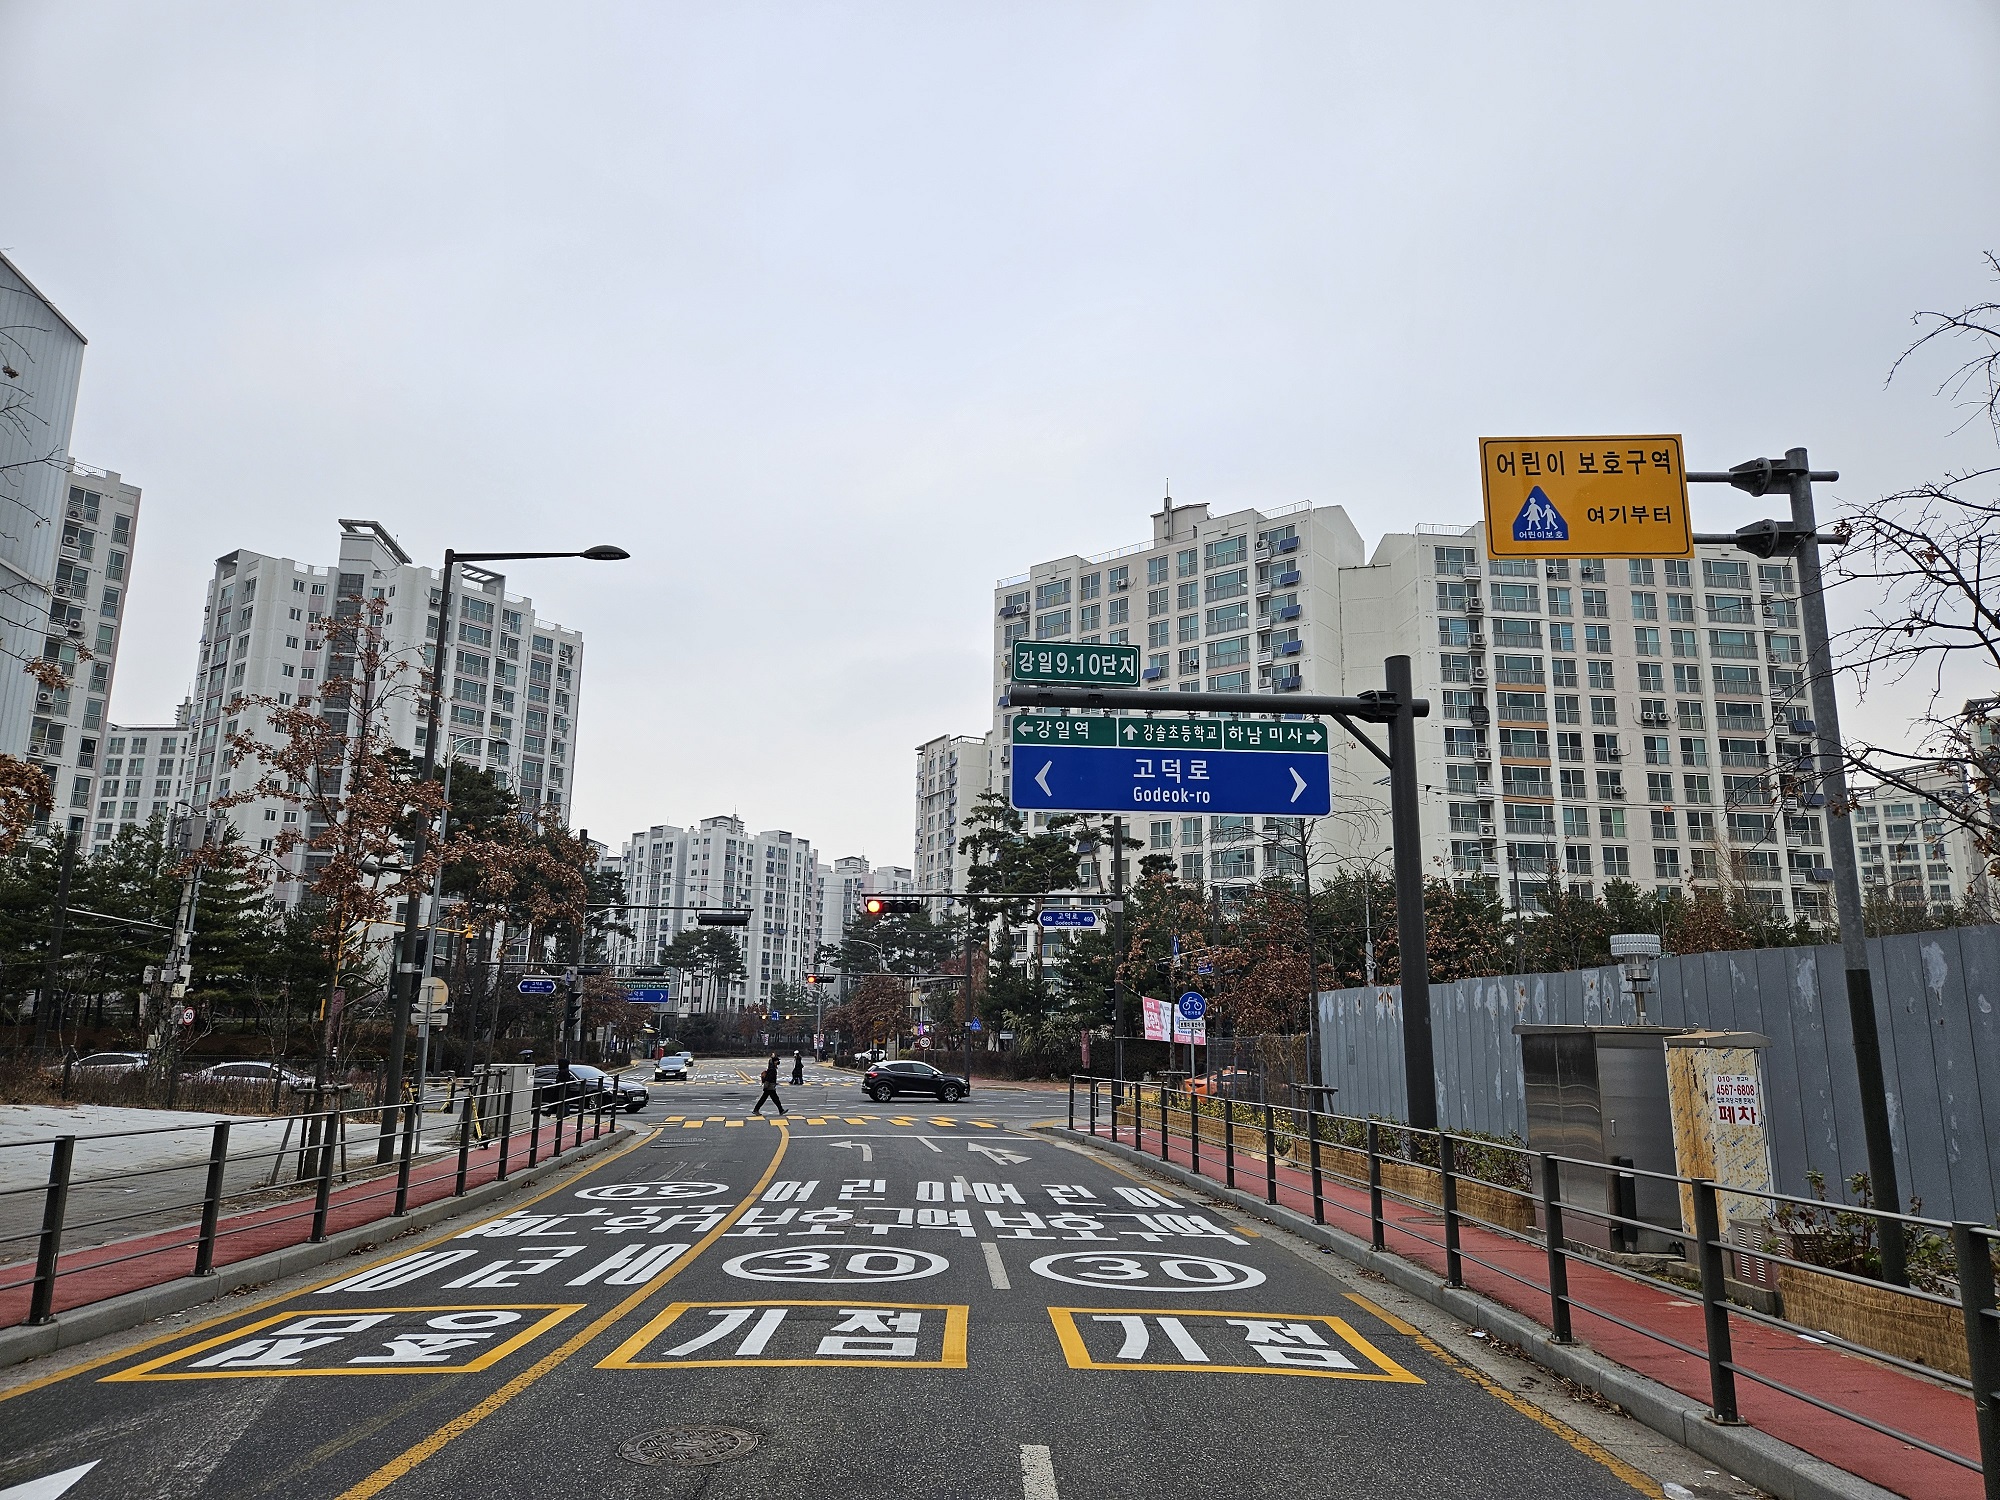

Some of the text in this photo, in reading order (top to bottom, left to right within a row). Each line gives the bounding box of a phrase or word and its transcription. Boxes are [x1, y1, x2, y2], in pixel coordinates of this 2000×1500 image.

[1497, 449, 1671, 476] 어린이 보호구역
[1587, 506, 1671, 524] 여기부터
[1519, 530, 1564, 539] 어린이보호
[1018, 650, 1135, 678] 강일9,10단지
[1036, 721, 1089, 740] 강일역
[1143, 724, 1218, 743] 강솔초등학교
[1133, 759, 1210, 783] 고덕로
[1133, 786, 1211, 804] Godeok-ro
[185, 1012, 193, 1020] 50
[921, 1038, 930, 1046] 30
[1718, 1105, 1757, 1124] 폐차
[760, 1179, 965, 1203] 어린이
[966, 1182, 1185, 1209] 어린이
[722, 1206, 976, 1238] 보호구역
[982, 1209, 1251, 1246] 보호구역
[765, 1251, 916, 1276] 30
[1072, 1256, 1238, 1285] 30
[663, 1308, 922, 1358] 기점
[1092, 1315, 1359, 1370] 기점
